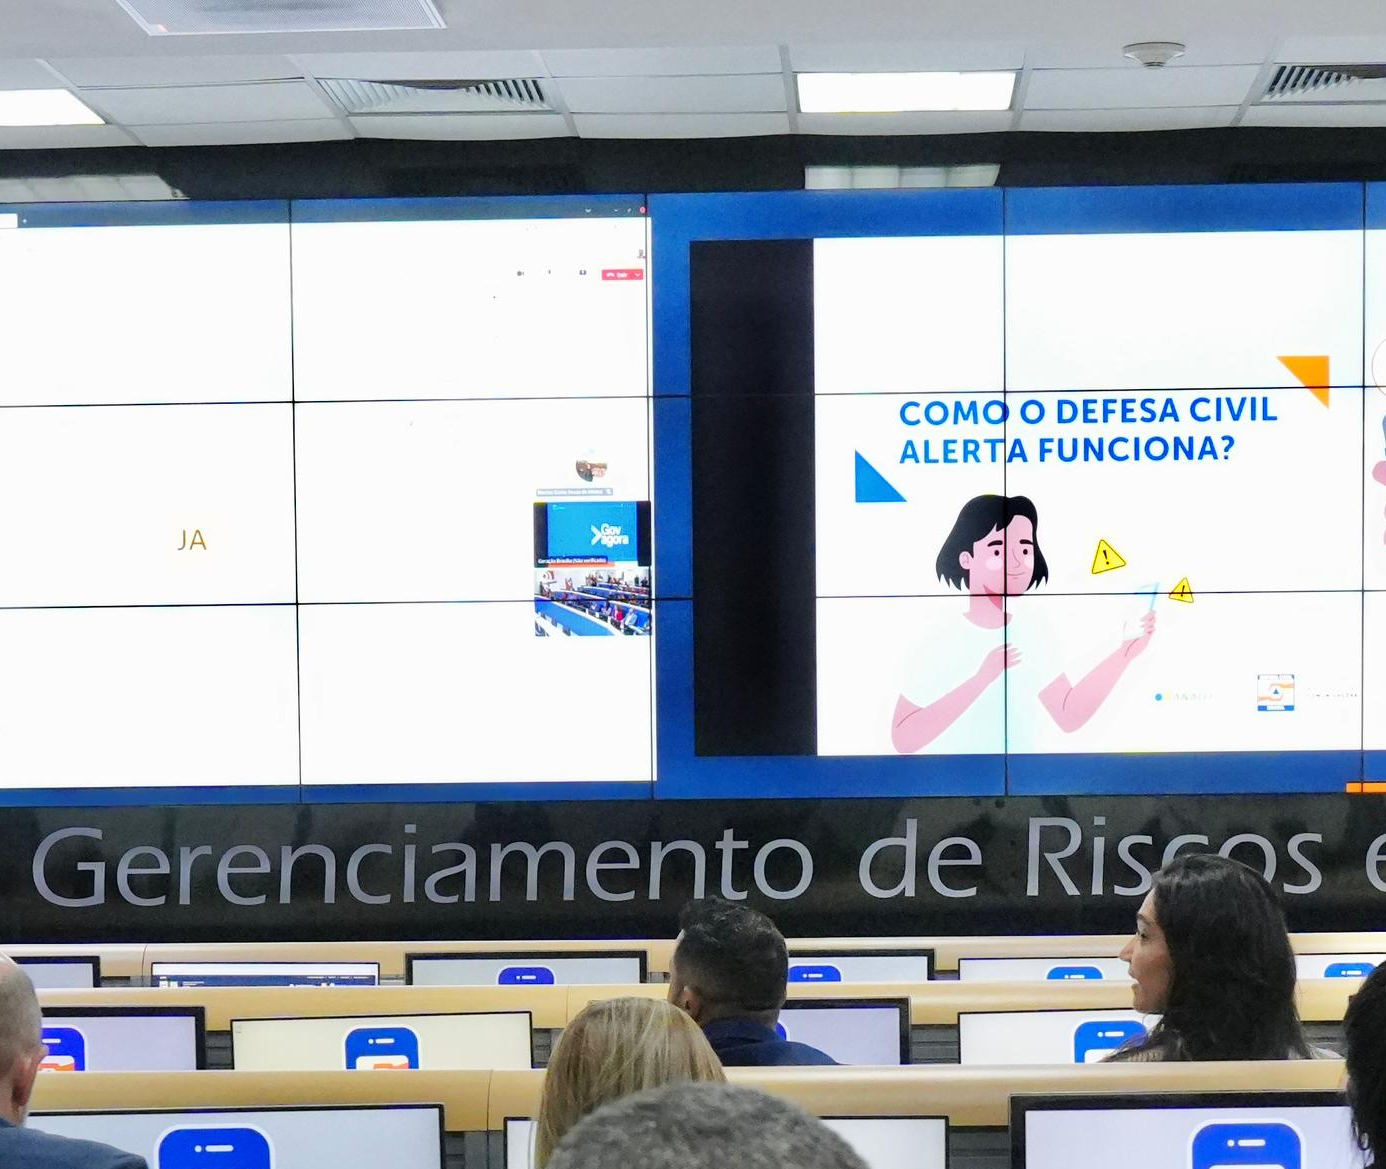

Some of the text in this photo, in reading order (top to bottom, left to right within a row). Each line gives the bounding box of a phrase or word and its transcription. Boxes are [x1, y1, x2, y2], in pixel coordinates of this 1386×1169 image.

[899, 397, 1278, 426] COMO O DEFESA CIVIL
[899, 435, 1235, 464] ALERTA FUNCIONA?
[177, 529, 207, 551] JA
[600, 522, 622, 536] Gov
[600, 533, 630, 548] agora
[32, 825, 815, 908] Gerenciamento
[859, 818, 983, 899] de
